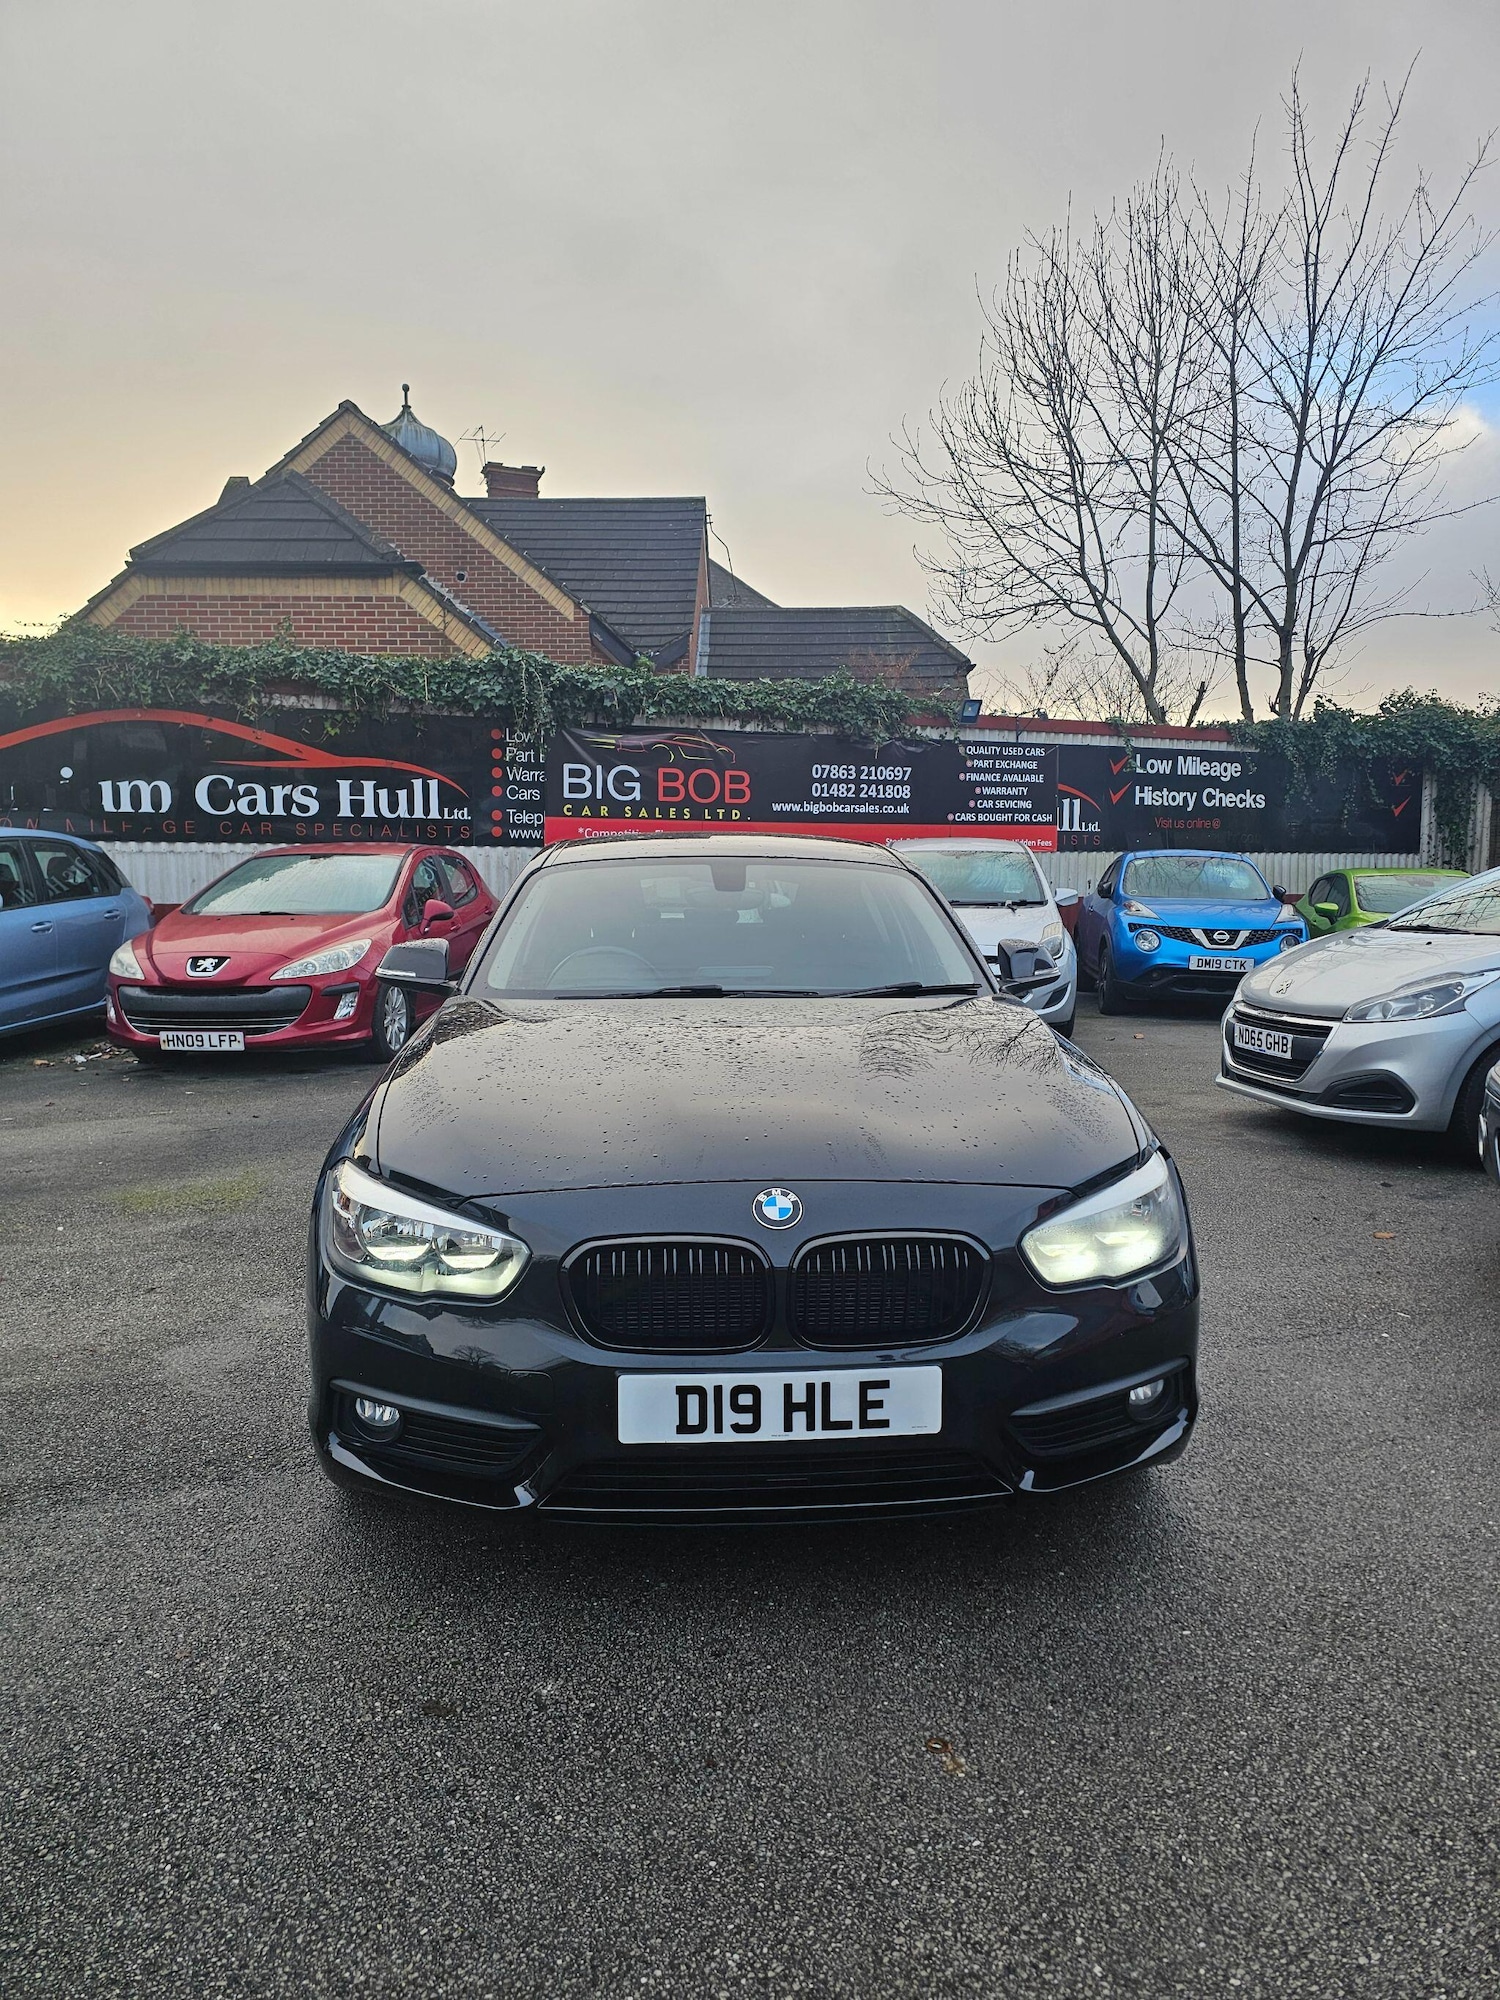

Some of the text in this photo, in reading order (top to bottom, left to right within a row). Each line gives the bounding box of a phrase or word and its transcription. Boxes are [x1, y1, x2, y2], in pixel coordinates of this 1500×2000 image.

[505, 747, 534, 763] Part
[966, 745, 1045, 756] QUALITY USED CARS
[973, 760, 1038, 769] PART EXCHANGE
[1135, 754, 1242, 782] Low Mileage
[811, 764, 912, 781] 07863 210697
[966, 773, 1044, 783] FINANCE AVALIABLE
[563, 763, 751, 804] BIG BOB
[195, 774, 319, 817] Cars
[336, 778, 442, 819] Hull
[443, 807, 471, 820] Ltd.
[506, 785, 540, 800] Cars
[811, 783, 911, 799] 01482 241808
[982, 787, 1028, 796] WARRANTY
[977, 800, 1032, 809] CAR SEVICING
[1134, 785, 1266, 812] History Checks
[563, 804, 751, 820] CAR SALES LTD.
[772, 801, 910, 814] www.bigbobcarsales.co.uk
[506, 809, 545, 827] Telep
[955, 813, 1053, 822] CARS BOUGHT FOR CASH
[1155, 817, 1172, 829] Visit
[1174, 819, 1185, 829] us
[219, 821, 273, 835] CAR
[295, 823, 470, 838] SPECIALISTS
[1082, 821, 1101, 832] Ltd.
[1037, 839, 1052, 847] Fees
[1196, 958, 1247, 970] DM19 CTK
[166, 1034, 237, 1048] HN09 LFP
[1238, 1026, 1289, 1054] ND65 GHB
[757, 1189, 797, 1202] BMW
[676, 1380, 890, 1434] D19 HLE
